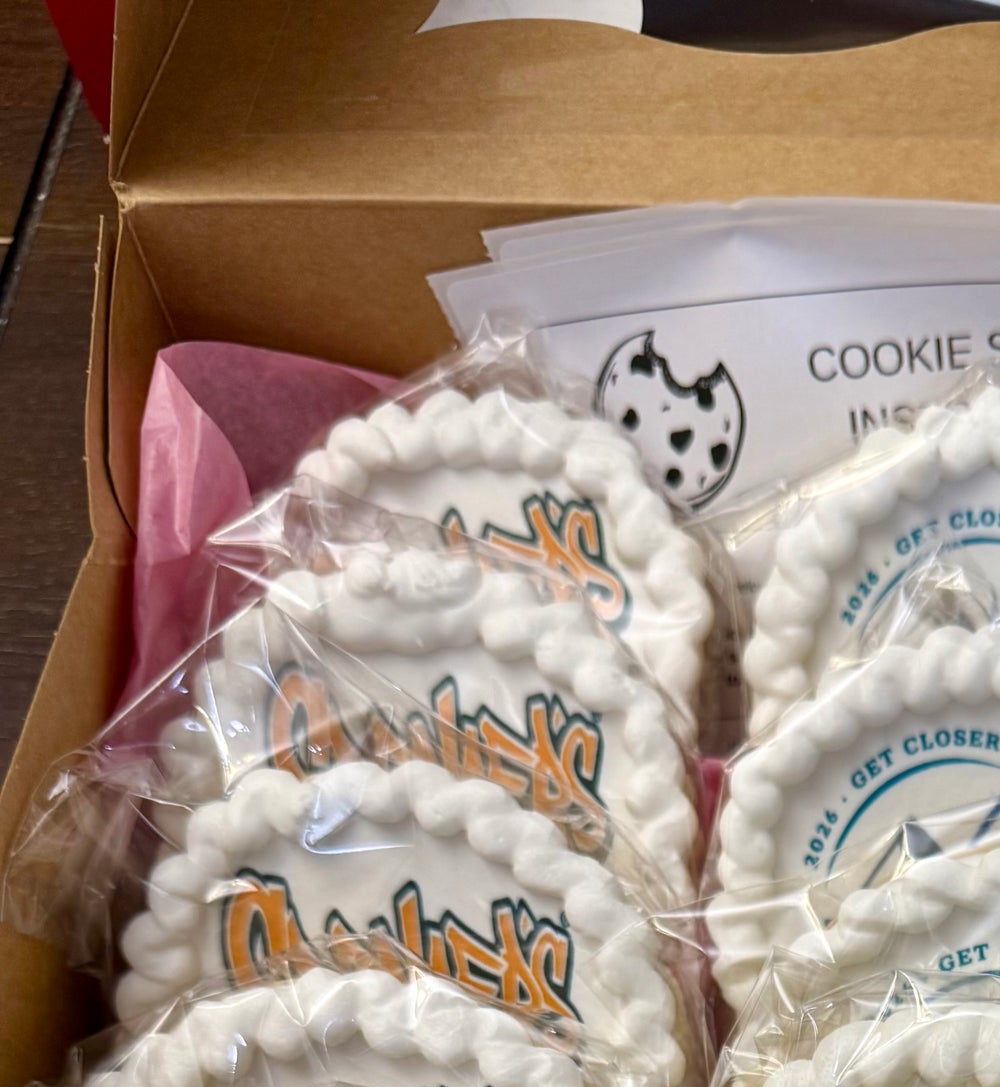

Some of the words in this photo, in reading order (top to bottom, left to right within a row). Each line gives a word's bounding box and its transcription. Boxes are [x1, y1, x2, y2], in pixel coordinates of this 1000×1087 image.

[808, 334, 972, 383] COOKIE
[803, 808, 838, 869] 2026
[850, 748, 895, 790] GET
[902, 729, 1000, 755] CLOSER
[937, 942, 989, 972] GET
